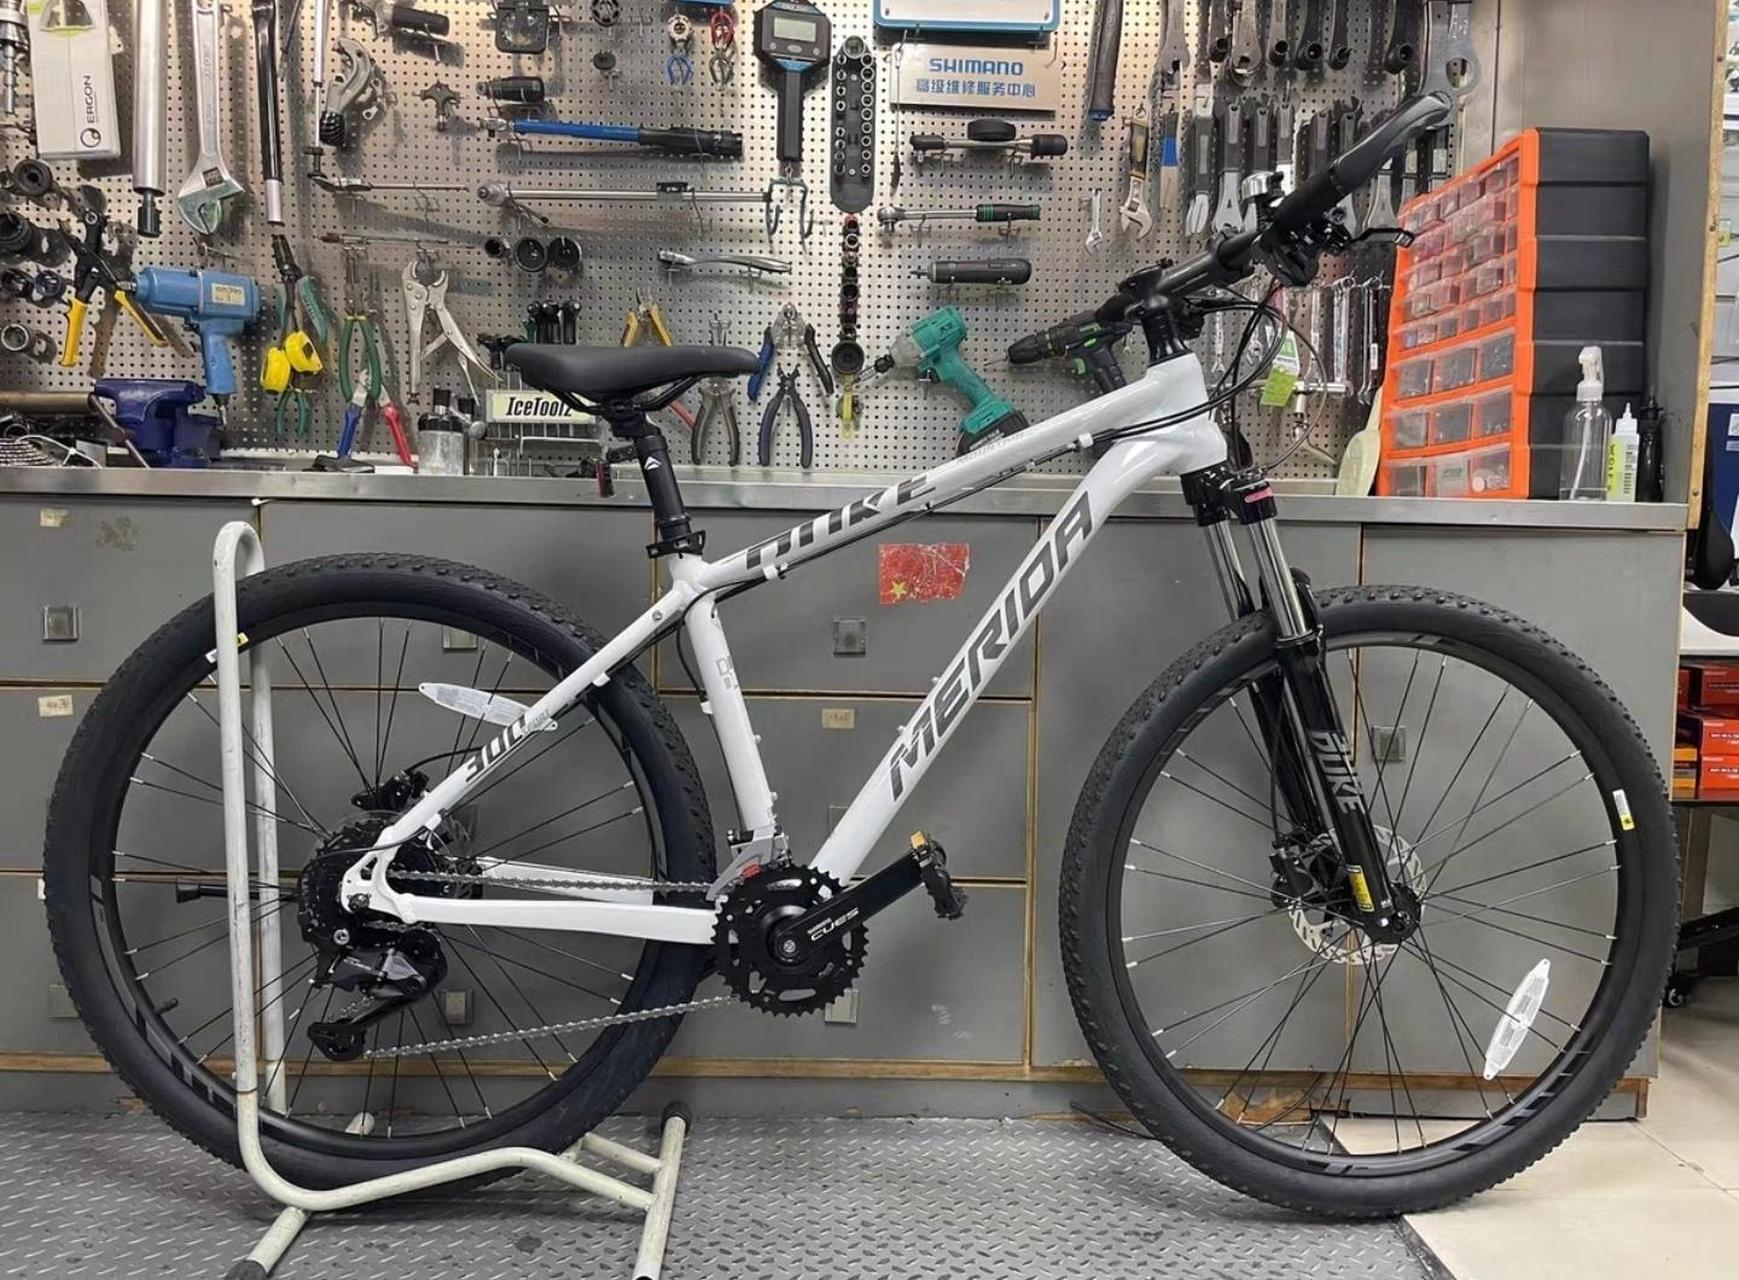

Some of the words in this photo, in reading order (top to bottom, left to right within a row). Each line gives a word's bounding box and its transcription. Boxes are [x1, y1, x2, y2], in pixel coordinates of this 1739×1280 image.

[916, 79, 1036, 98] 高级维修服务中心
[929, 58, 1024, 76] SHIMANO
[83, 75, 95, 124] ERGON
[889, 490, 1094, 802] MERIDA
[1308, 729, 1366, 814] DUKE
